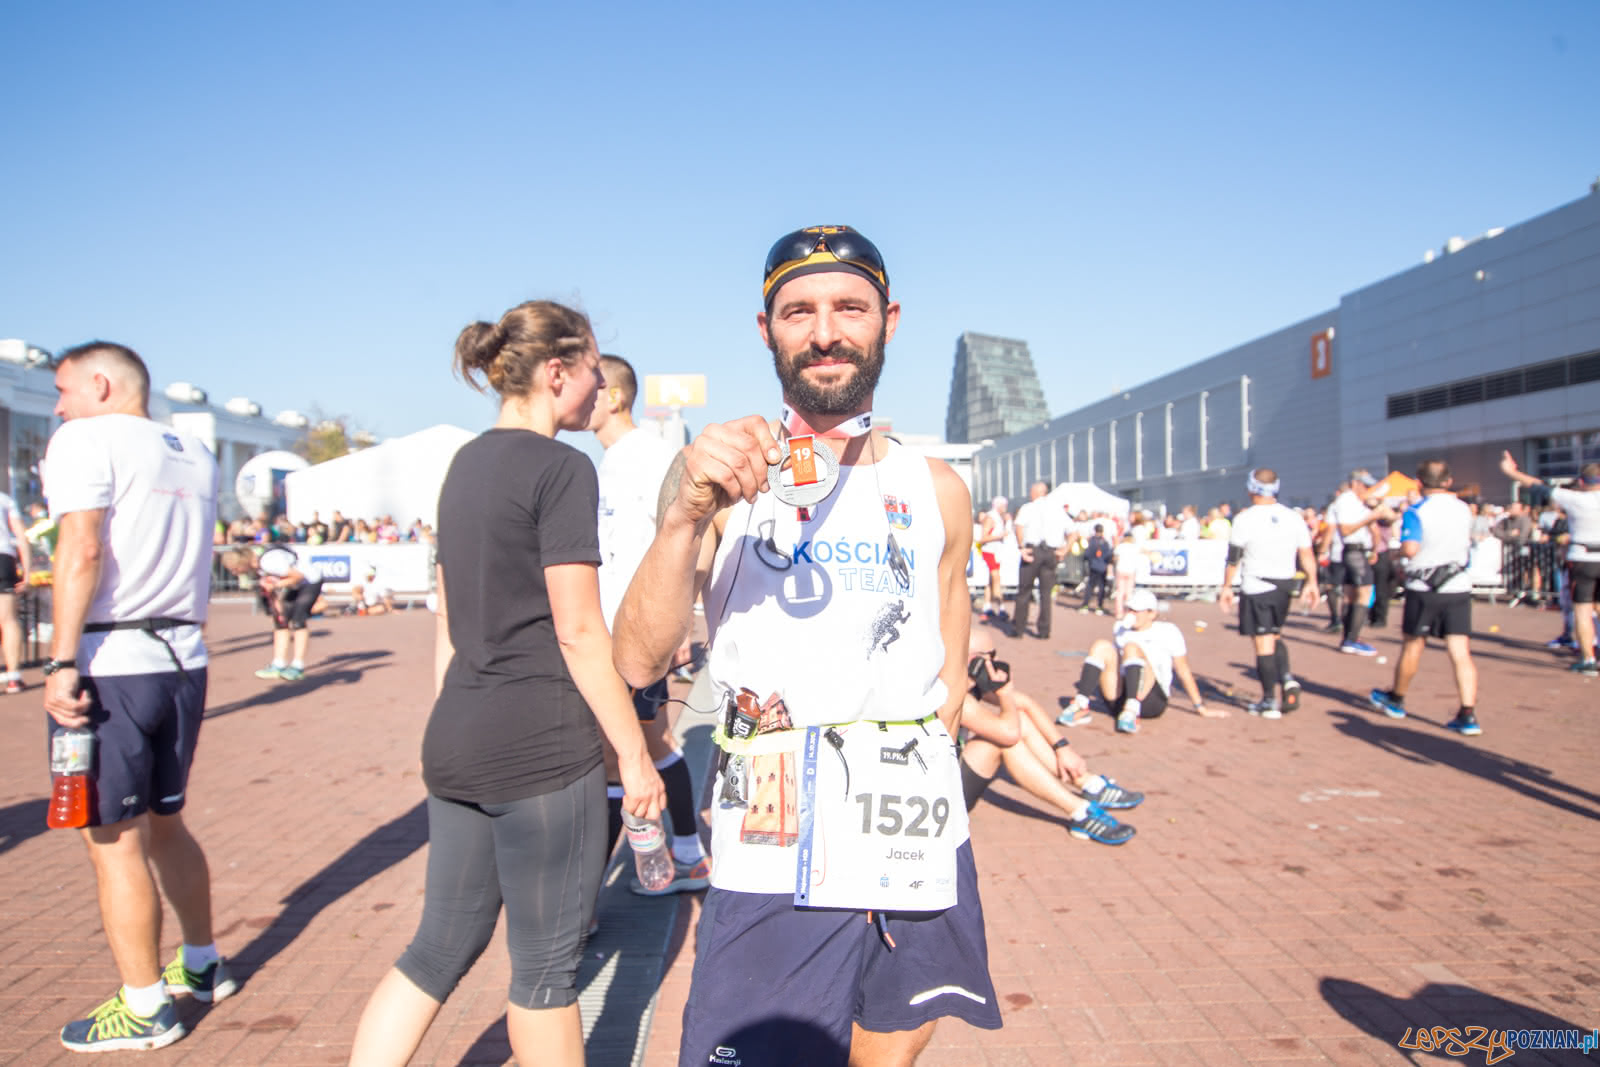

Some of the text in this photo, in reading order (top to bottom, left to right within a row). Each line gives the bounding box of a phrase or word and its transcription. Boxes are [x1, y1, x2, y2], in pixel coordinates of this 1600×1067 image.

[793, 447, 811, 462] 19
[855, 792, 950, 838] 1529
[886, 847, 925, 861] Jacek
